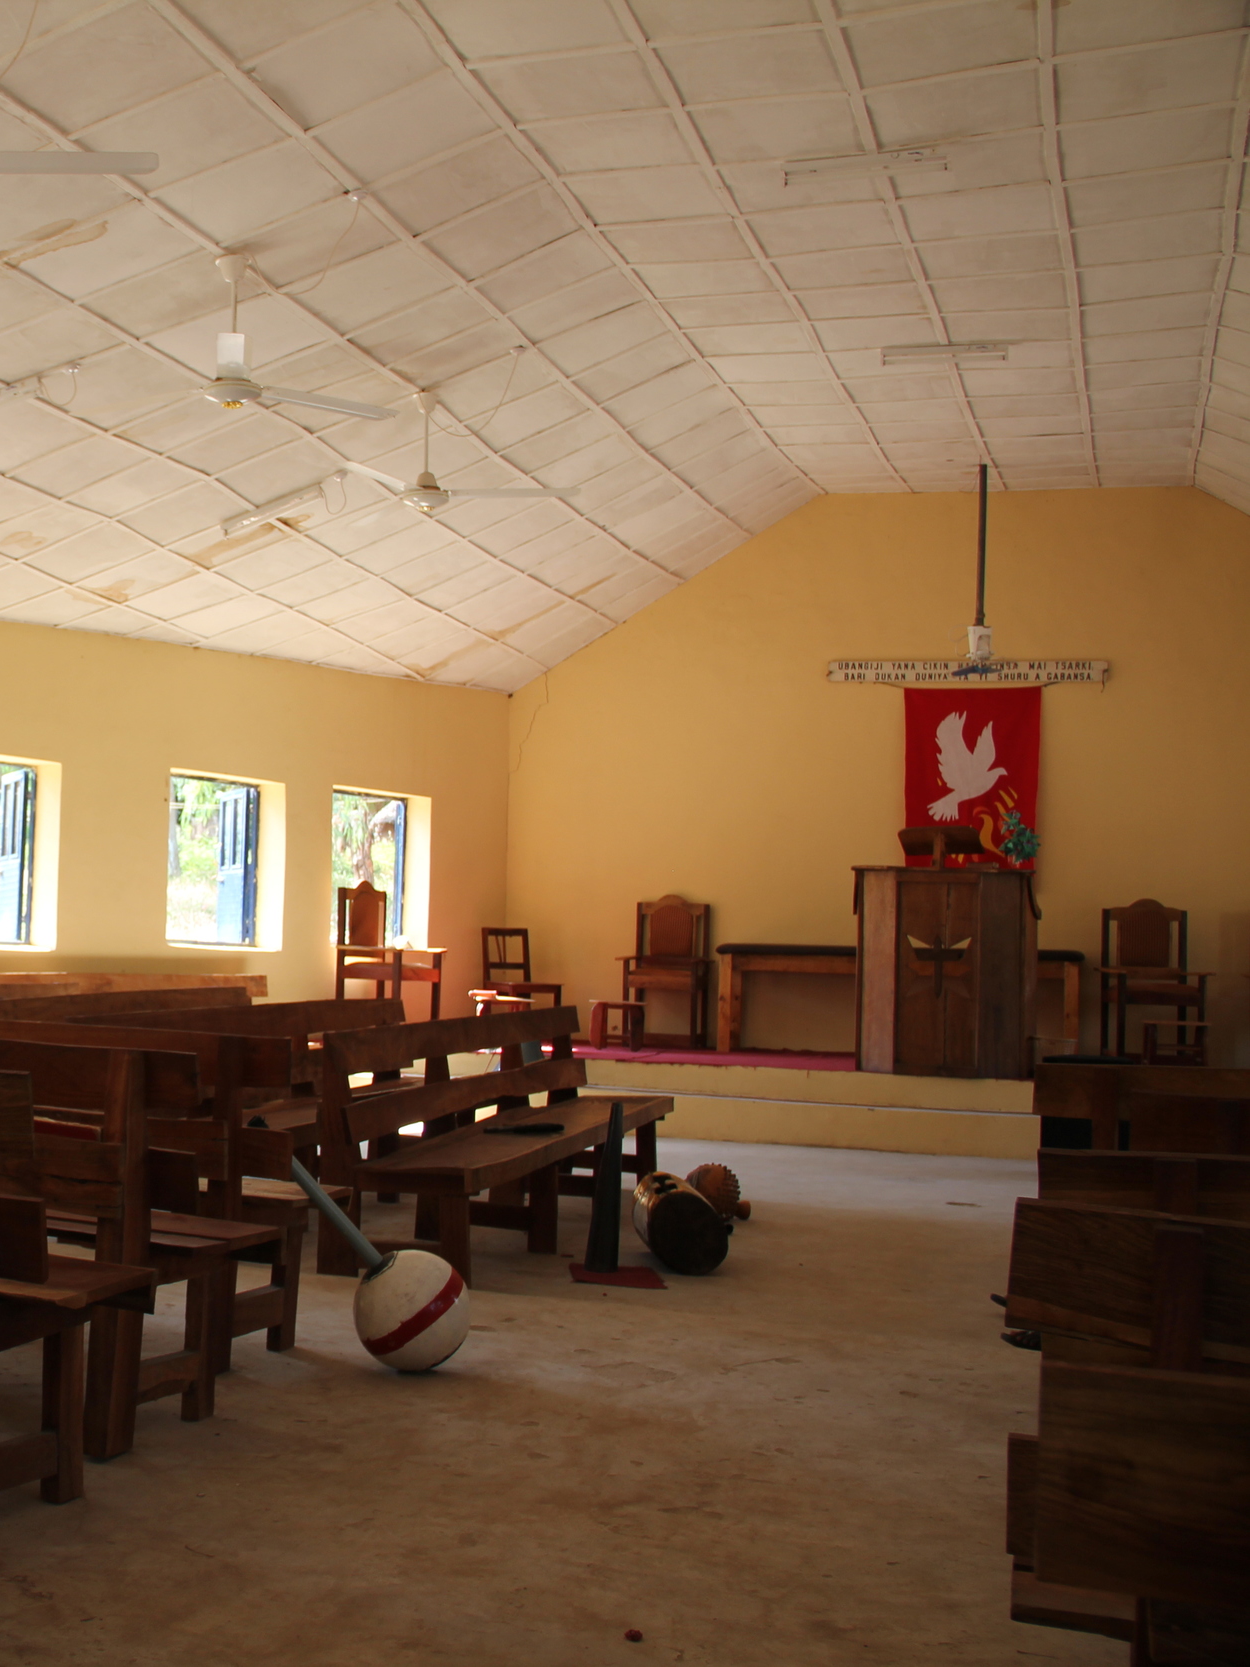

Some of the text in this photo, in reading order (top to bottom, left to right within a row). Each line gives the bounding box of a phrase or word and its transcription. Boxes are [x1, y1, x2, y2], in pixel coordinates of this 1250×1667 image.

[837, 662, 883, 670] UBANGIJI
[891, 662, 916, 670] YANA
[922, 662, 949, 670] CIKIN
[1028, 662, 1047, 671] MAI
[844, 672, 866, 681] BARI
[997, 672, 1029, 681] SHURU
[1034, 672, 1041, 681] A
